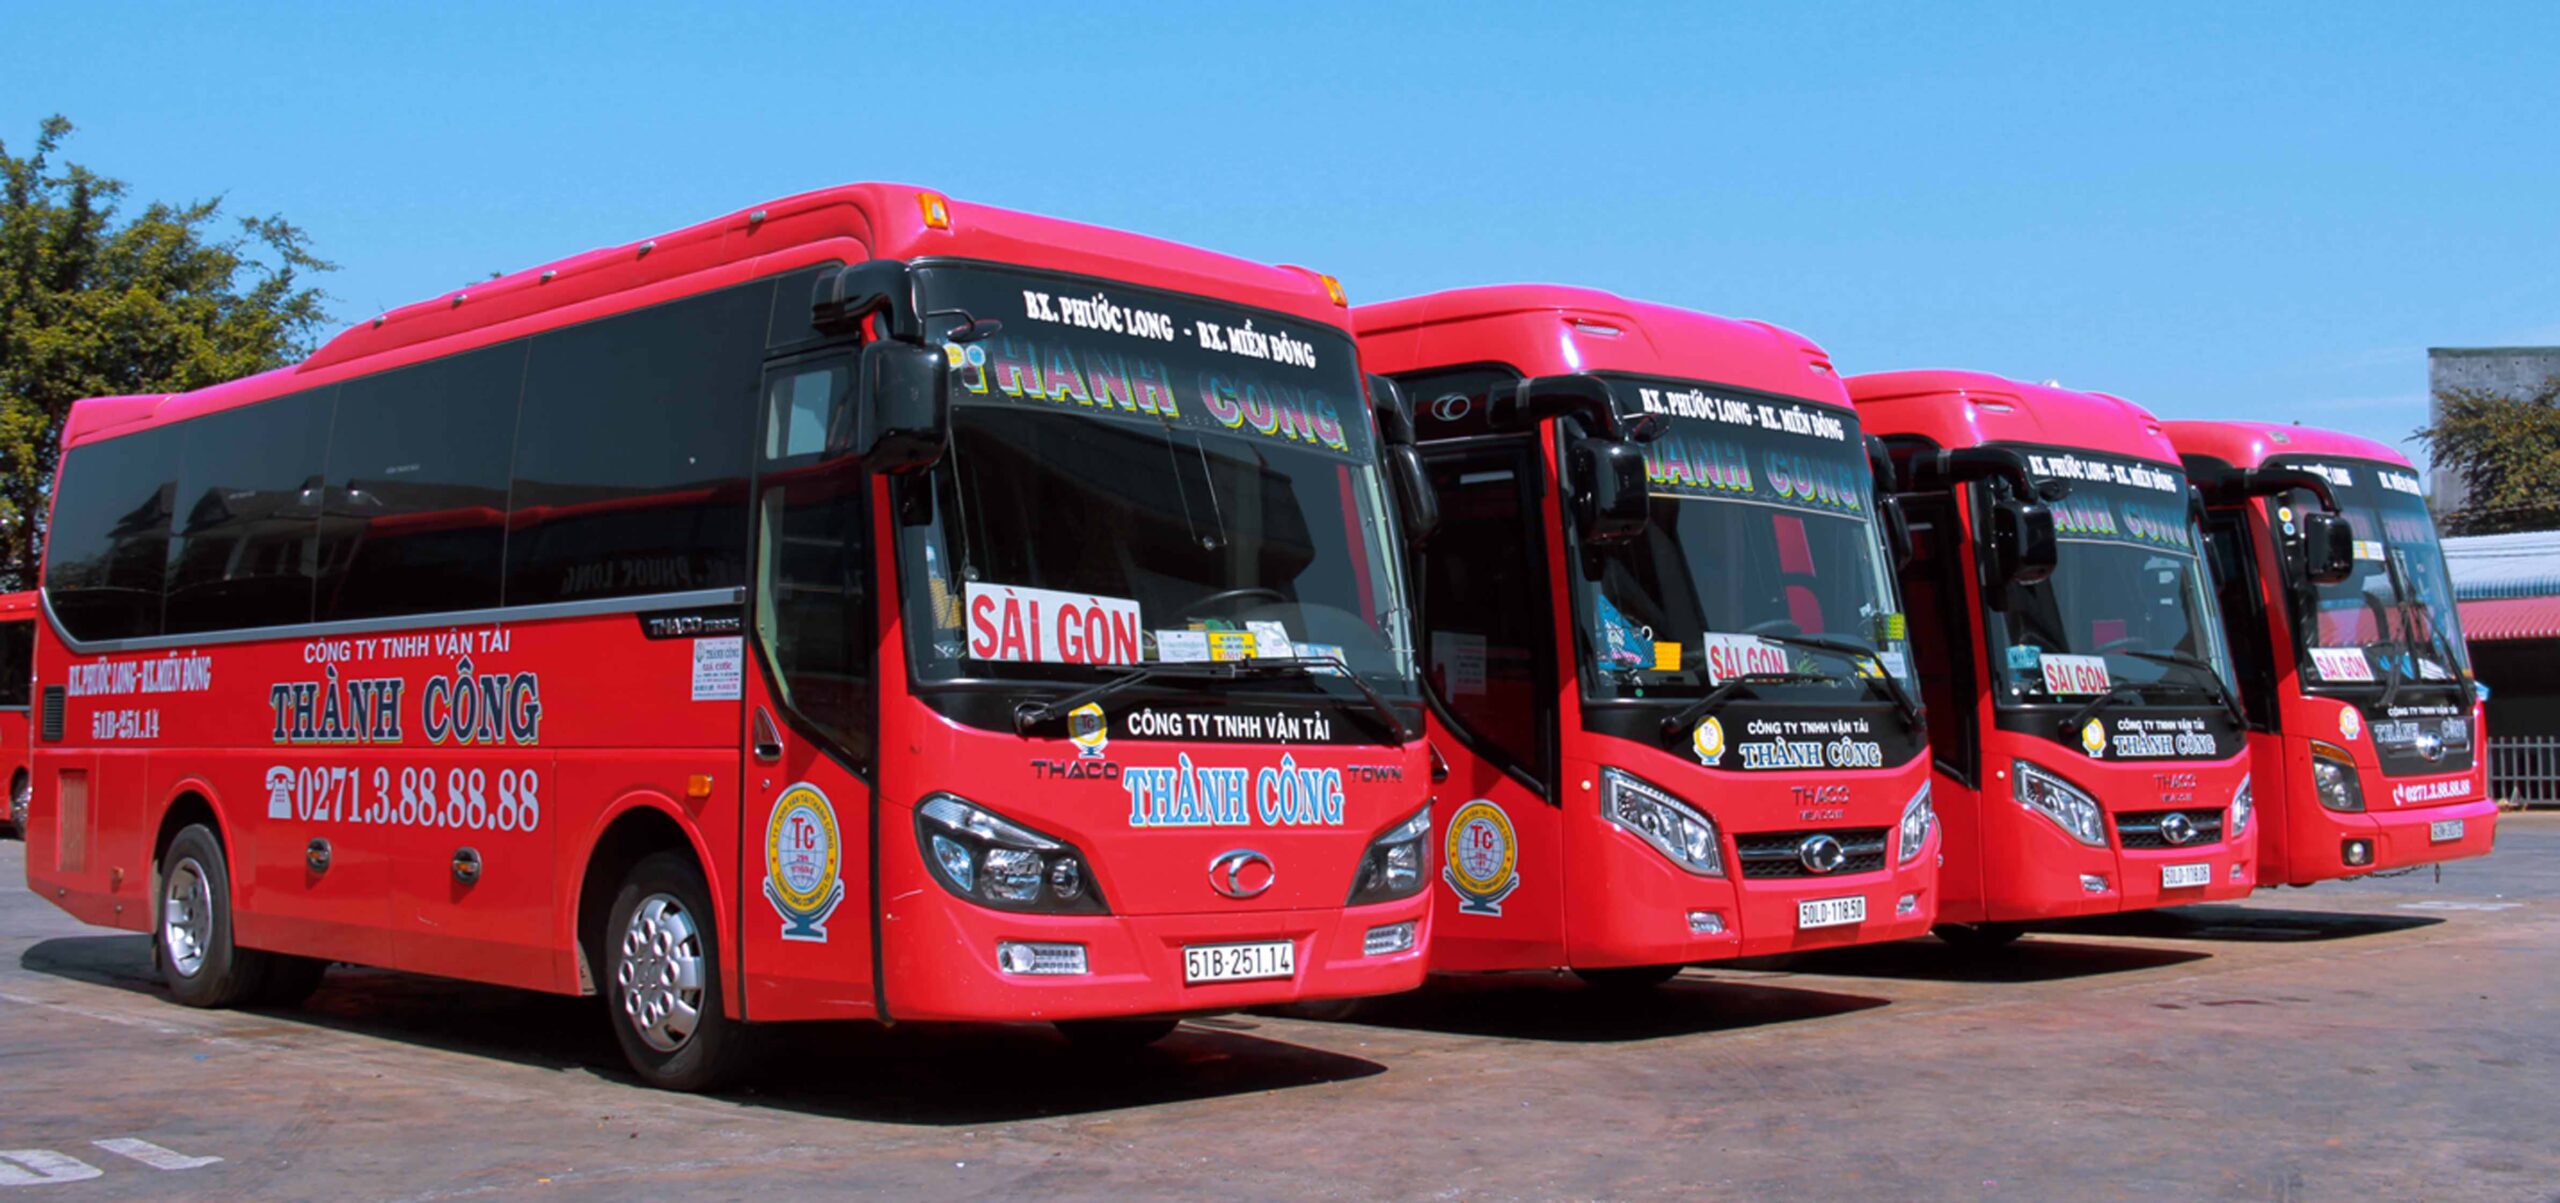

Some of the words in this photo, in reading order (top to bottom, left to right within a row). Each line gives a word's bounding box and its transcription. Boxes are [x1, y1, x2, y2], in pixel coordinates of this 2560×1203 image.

[1022, 290, 1060, 322] BX.
[1123, 308, 1175, 342] LONG
[1196, 320, 1229, 351] BX.
[1269, 331, 1317, 369] ĐÔNG
[1715, 397, 1753, 427] LONG
[971, 587, 1043, 663] SÀI
[1056, 597, 1139, 666] GÒN
[304, 636, 352, 664] CÔNG
[355, 638, 377, 661] TY
[381, 635, 430, 659] TNHH
[435, 627, 474, 660] VẬN
[2045, 656, 2074, 692] SÀI
[270, 662, 405, 744] THÀNH
[422, 654, 543, 746] CÔNG
[92, 708, 161, 740] 51B-251.14
[1127, 708, 1184, 736] CÔNG
[1186, 714, 1210, 736] TY
[1213, 714, 1262, 739] TNHH
[1267, 711, 1302, 744] VẬN
[1304, 710, 1331, 741] TẢI
[1747, 718, 1782, 736] CÔNG
[1783, 721, 1799, 735] TY
[1799, 721, 1829, 735] TNHH
[1738, 736, 1825, 769] THÀNH
[1826, 736, 1883, 768] CÔNG
[2113, 729, 2175, 756] THÀNH
[2175, 730, 2216, 756] CÔNG
[1030, 760, 1119, 780] THACO
[1347, 763, 1403, 783] TOWN
[296, 765, 541, 833] 0271.3.88.88.88
[1123, 750, 1251, 826] THÀNH
[1256, 750, 1346, 826] CÔNG
[1802, 899, 1864, 925] 50LD-118.50
[1188, 946, 1291, 978] 51B-251.14
